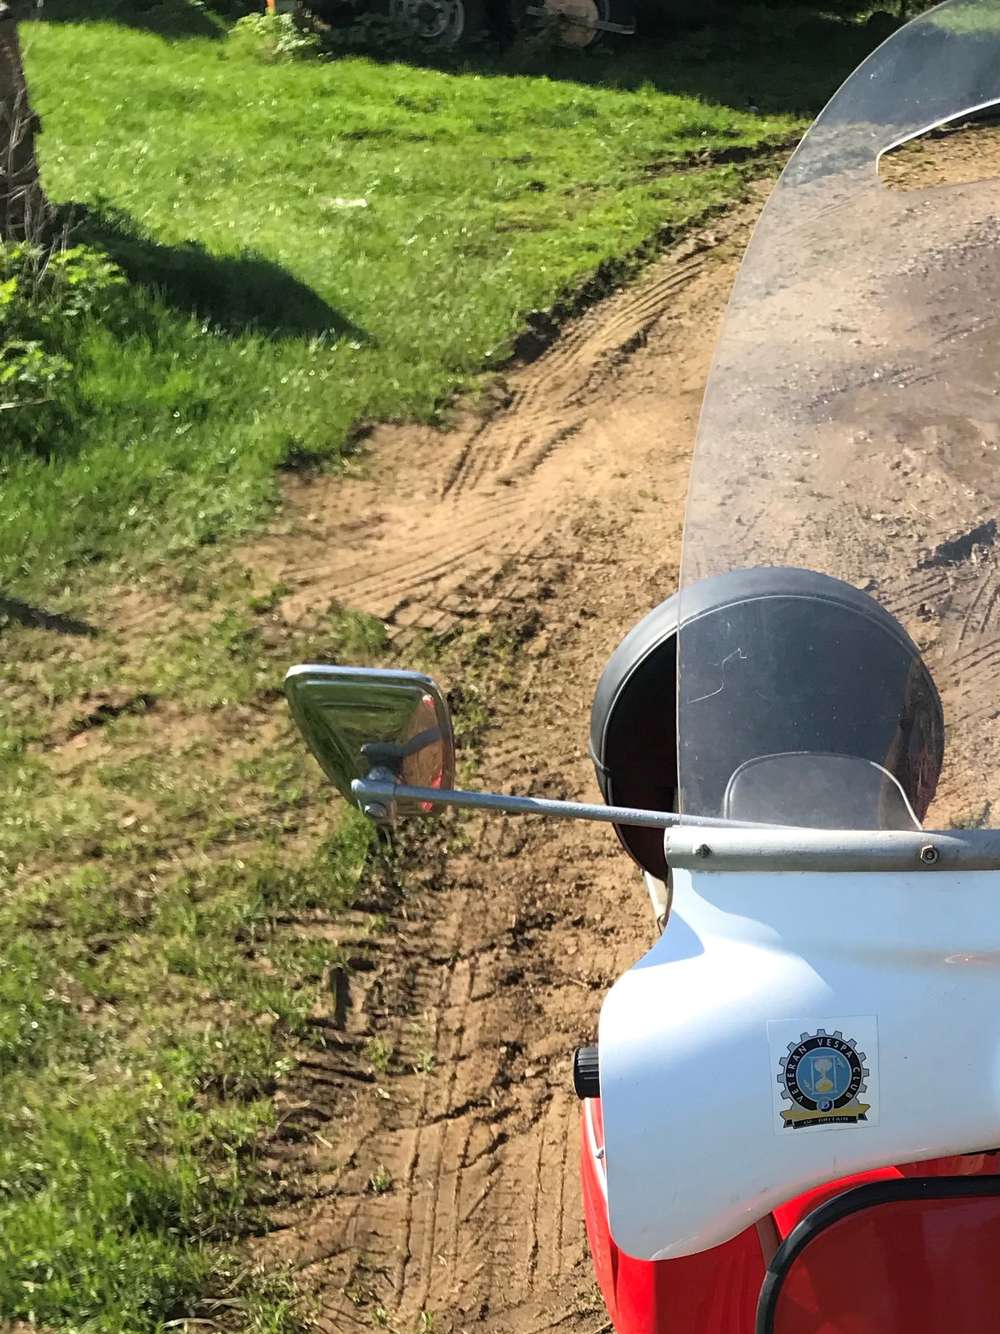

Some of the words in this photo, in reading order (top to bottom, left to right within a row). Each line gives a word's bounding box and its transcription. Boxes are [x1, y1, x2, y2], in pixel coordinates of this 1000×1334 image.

[787, 1045, 808, 1103] VETERAN
[816, 1038, 854, 1058] VESPA
[845, 1066, 861, 1100] CLUB
